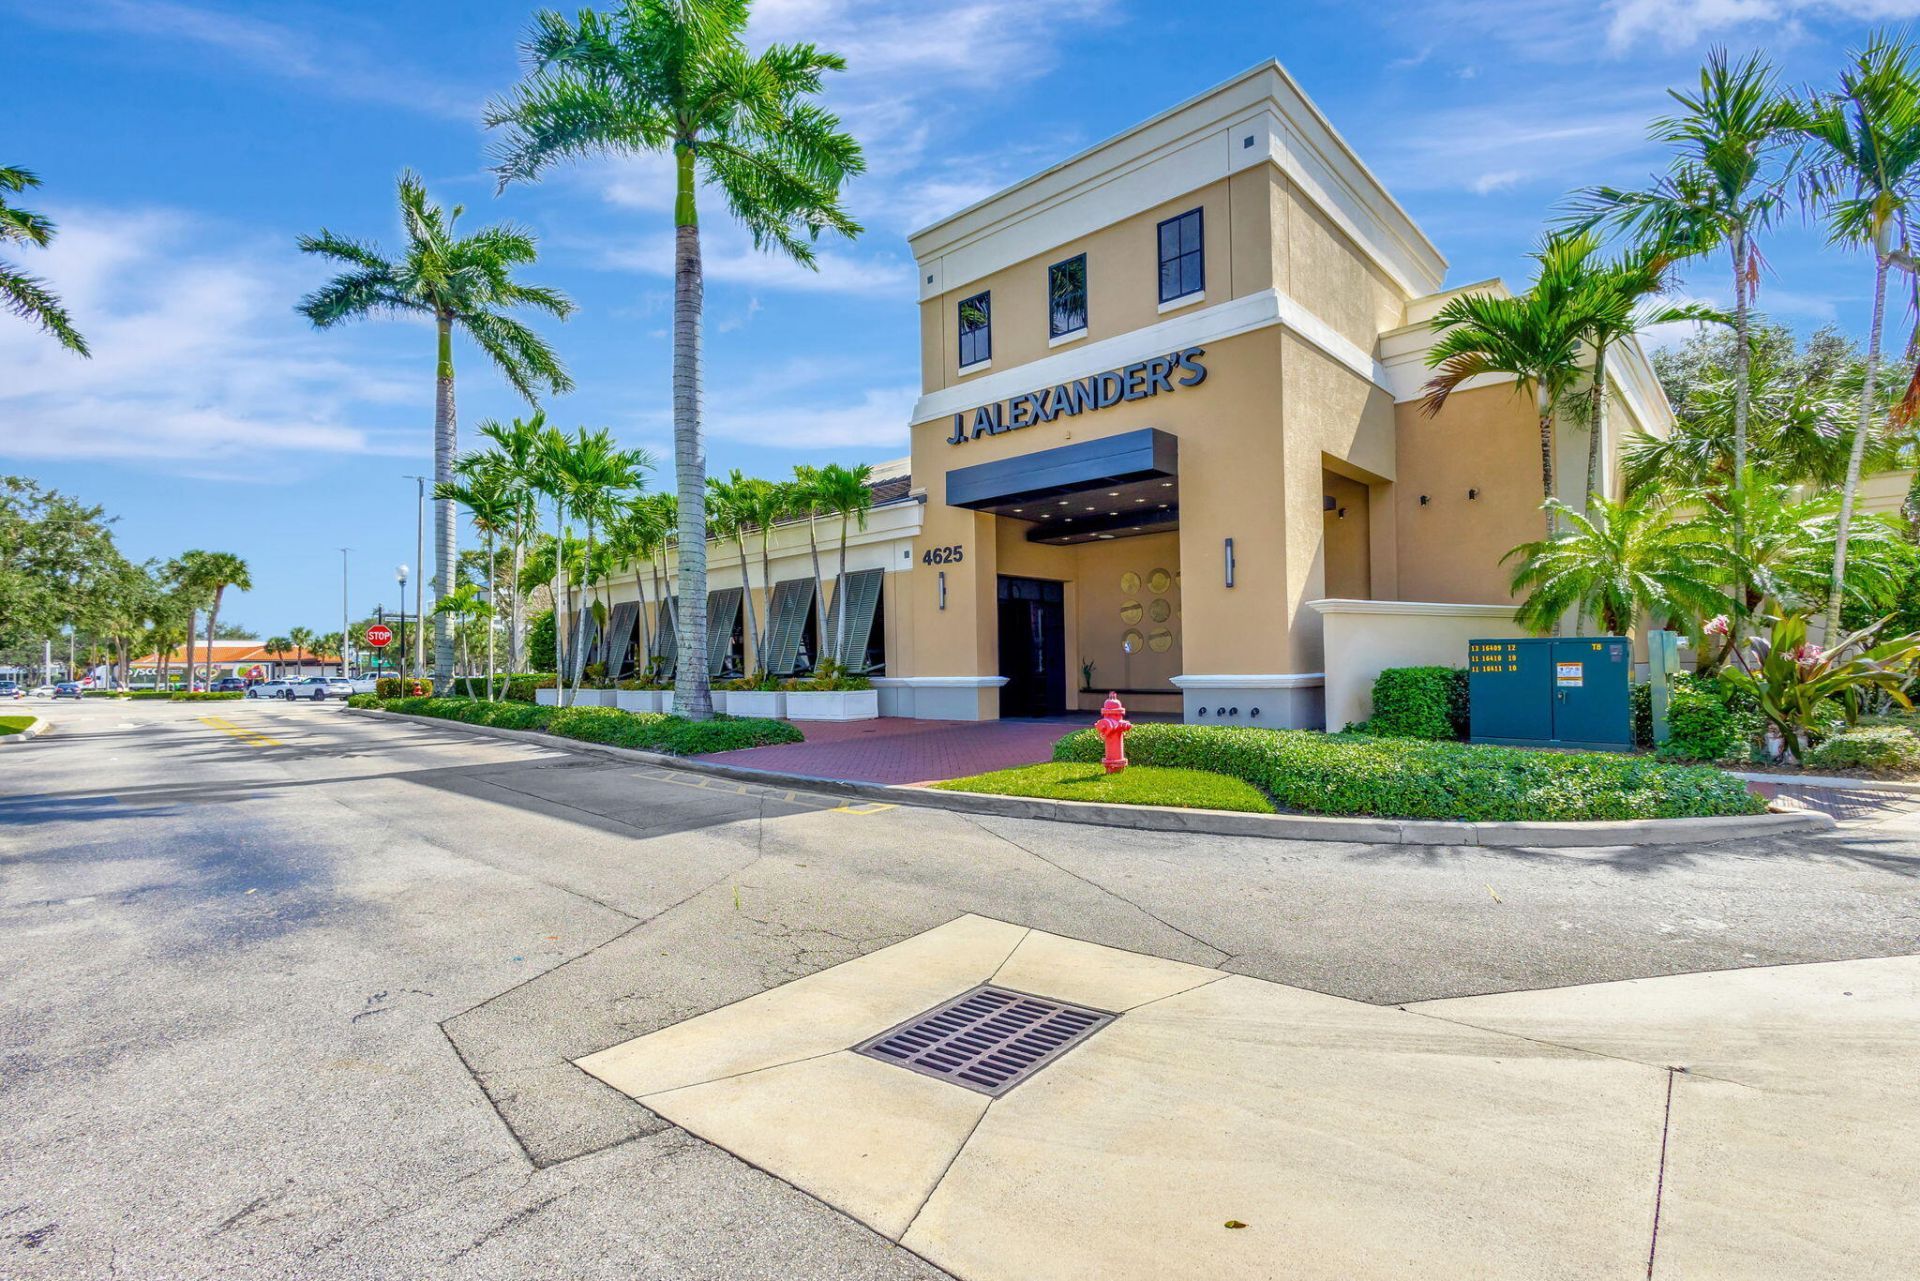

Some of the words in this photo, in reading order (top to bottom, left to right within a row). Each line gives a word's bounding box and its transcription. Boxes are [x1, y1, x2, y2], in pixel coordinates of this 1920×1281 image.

[946, 412, 968, 445] J.
[970, 346, 1208, 440] ALEXANDER'S
[922, 544, 964, 566] 4625
[368, 631, 391, 640] STOP
